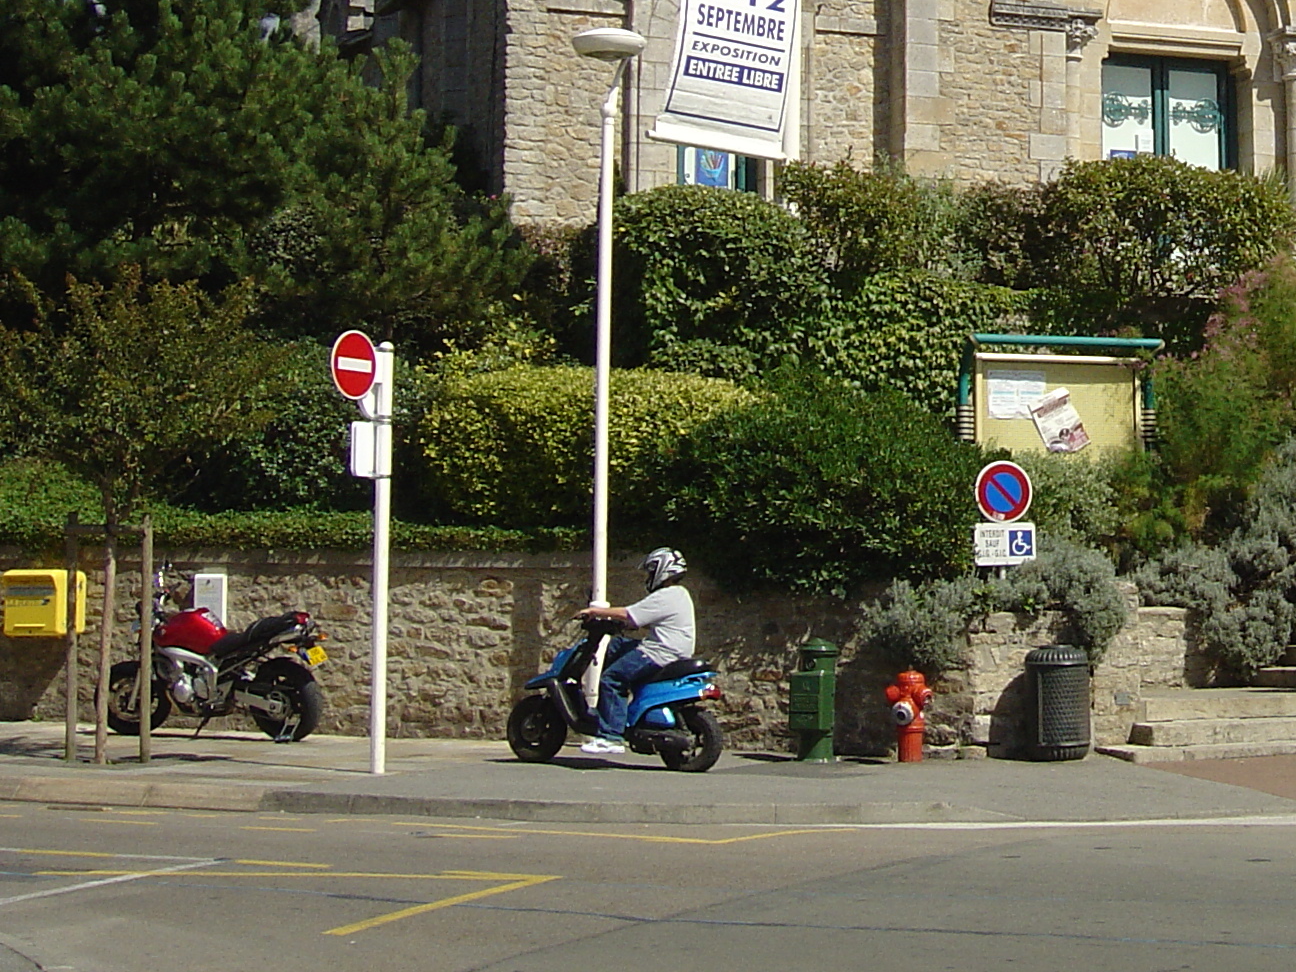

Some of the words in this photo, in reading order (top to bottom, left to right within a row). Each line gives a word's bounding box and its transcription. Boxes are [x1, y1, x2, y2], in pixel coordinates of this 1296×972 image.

[697, 3, 785, 41] SEPTEMBRE
[692, 40, 781, 66] EXPOSITION
[688, 58, 740, 82] ENTREE
[742, 68, 780, 89] LIBRE
